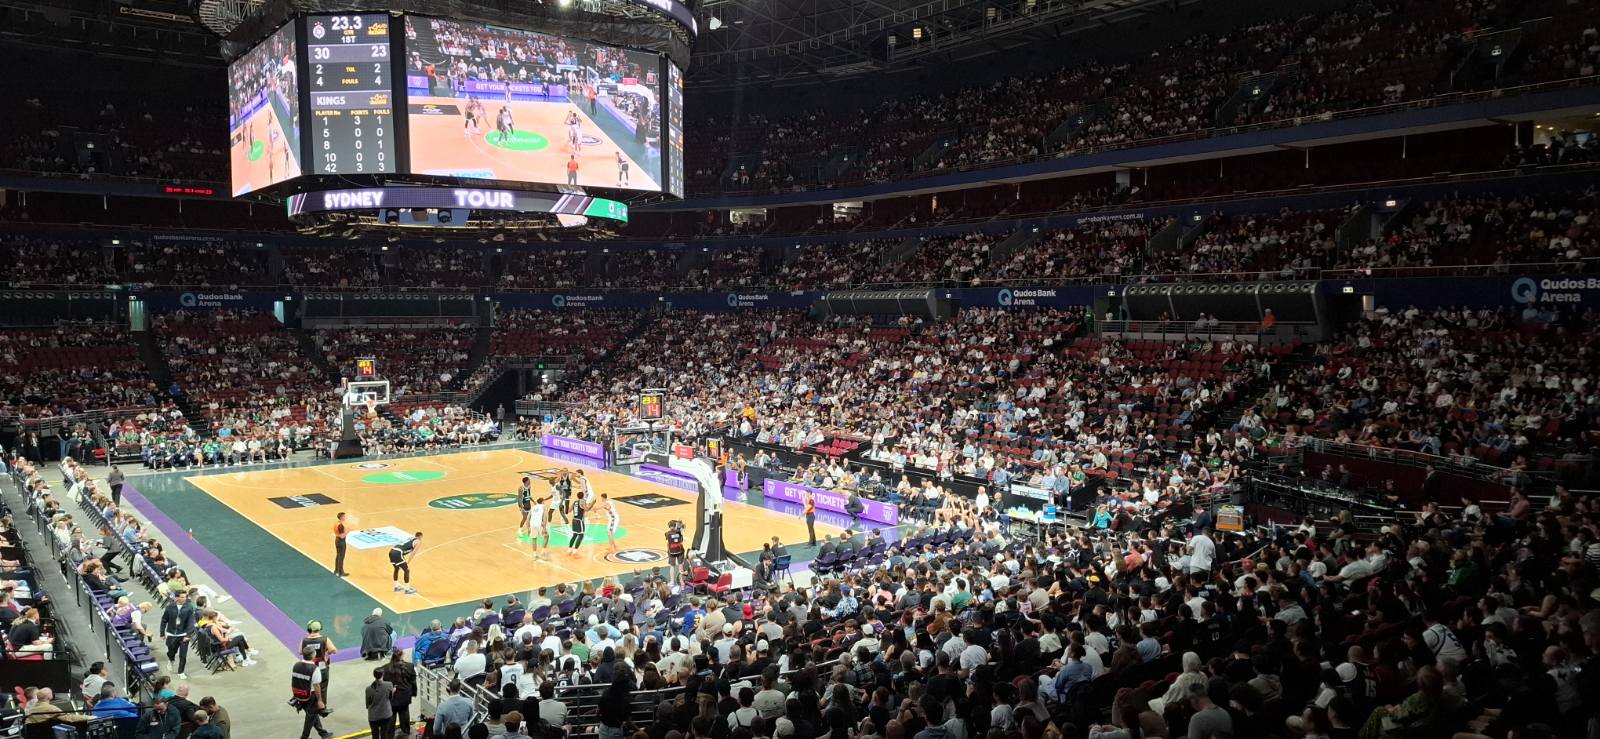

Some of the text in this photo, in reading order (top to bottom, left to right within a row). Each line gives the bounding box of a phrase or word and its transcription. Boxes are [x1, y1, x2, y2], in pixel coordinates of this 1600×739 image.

[331, 16, 362, 30] 23.3
[314, 46, 387, 60] 30 23
[316, 64, 323, 74] 2
[374, 64, 381, 73] 2
[316, 76, 324, 86] 4
[374, 76, 382, 86] 4
[316, 96, 346, 106] KINGS
[323, 116, 382, 126] 1 3 1
[323, 128, 383, 138] 5 0 0
[324, 140, 383, 150] 8 0 1
[324, 152, 384, 162] 10 0 0
[324, 162, 385, 172] 42 3 3
[325, 190, 514, 208] SYDNEY TOUR
[1540, 278, 1586, 290] Qudos
[1540, 292, 1581, 302] Arena
[648, 405, 658, 416] 14
[784, 487, 798, 497] GET
[816, 494, 844, 508] TICKETS
